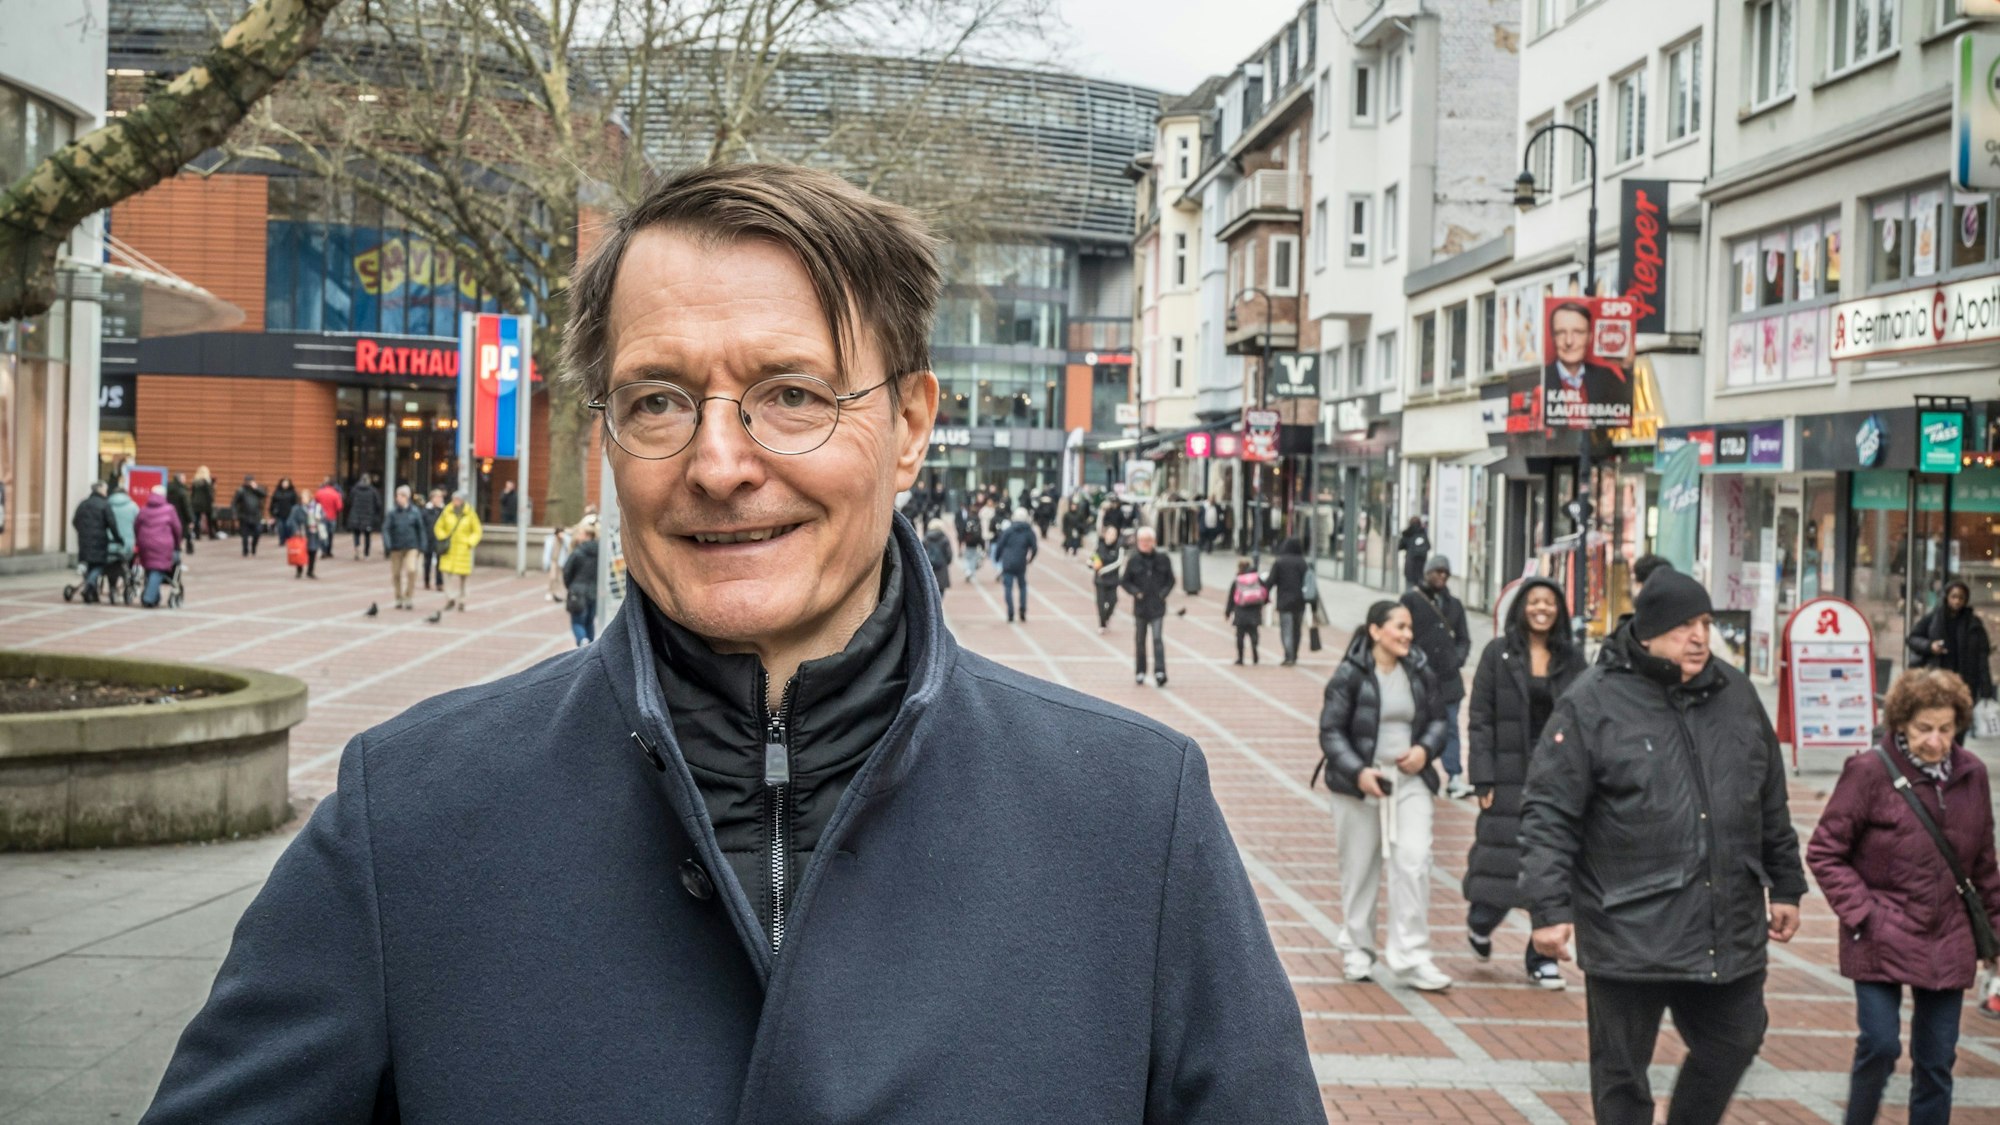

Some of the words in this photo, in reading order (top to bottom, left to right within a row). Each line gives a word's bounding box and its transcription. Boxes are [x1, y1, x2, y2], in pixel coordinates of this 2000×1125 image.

[357, 243, 486, 293] SMYT
[1601, 302, 1632, 316] SPD
[1853, 300, 1927, 345] Germania
[1952, 286, 2000, 342] Apot
[356, 339, 460, 378] RATHAU
[1547, 390, 1582, 403] KARL
[1547, 403, 1631, 417] LAUTERBACH
